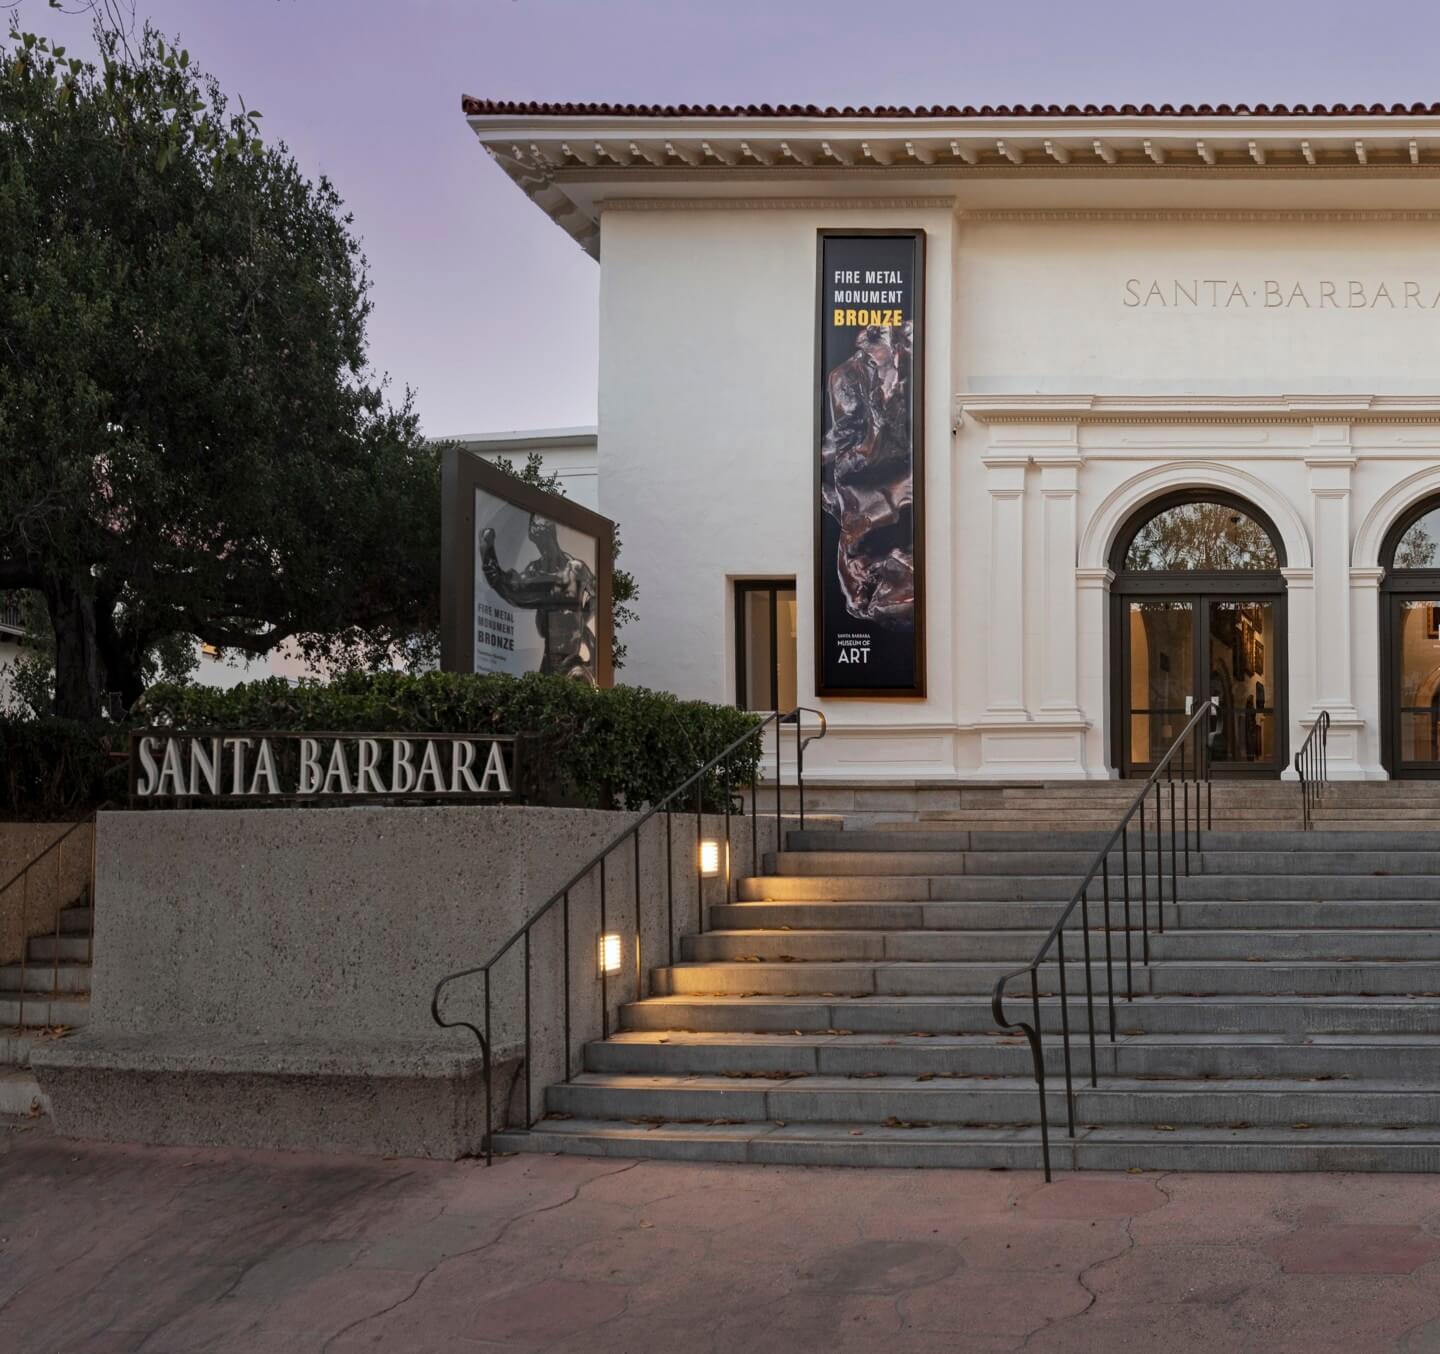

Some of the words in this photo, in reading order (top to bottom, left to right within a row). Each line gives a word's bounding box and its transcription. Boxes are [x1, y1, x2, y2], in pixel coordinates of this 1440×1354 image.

[834, 270, 860, 284] FIRE
[865, 270, 903, 284] METAL
[834, 290, 903, 304] MONUMENT
[833, 309, 903, 327] BRONZE
[478, 603, 493, 617] FIRE
[494, 608, 514, 624] METAL
[478, 630, 514, 652] BRONZE
[837, 647, 871, 664] ART
[137, 736, 281, 796] SANTA
[298, 737, 512, 794] BARBARA
